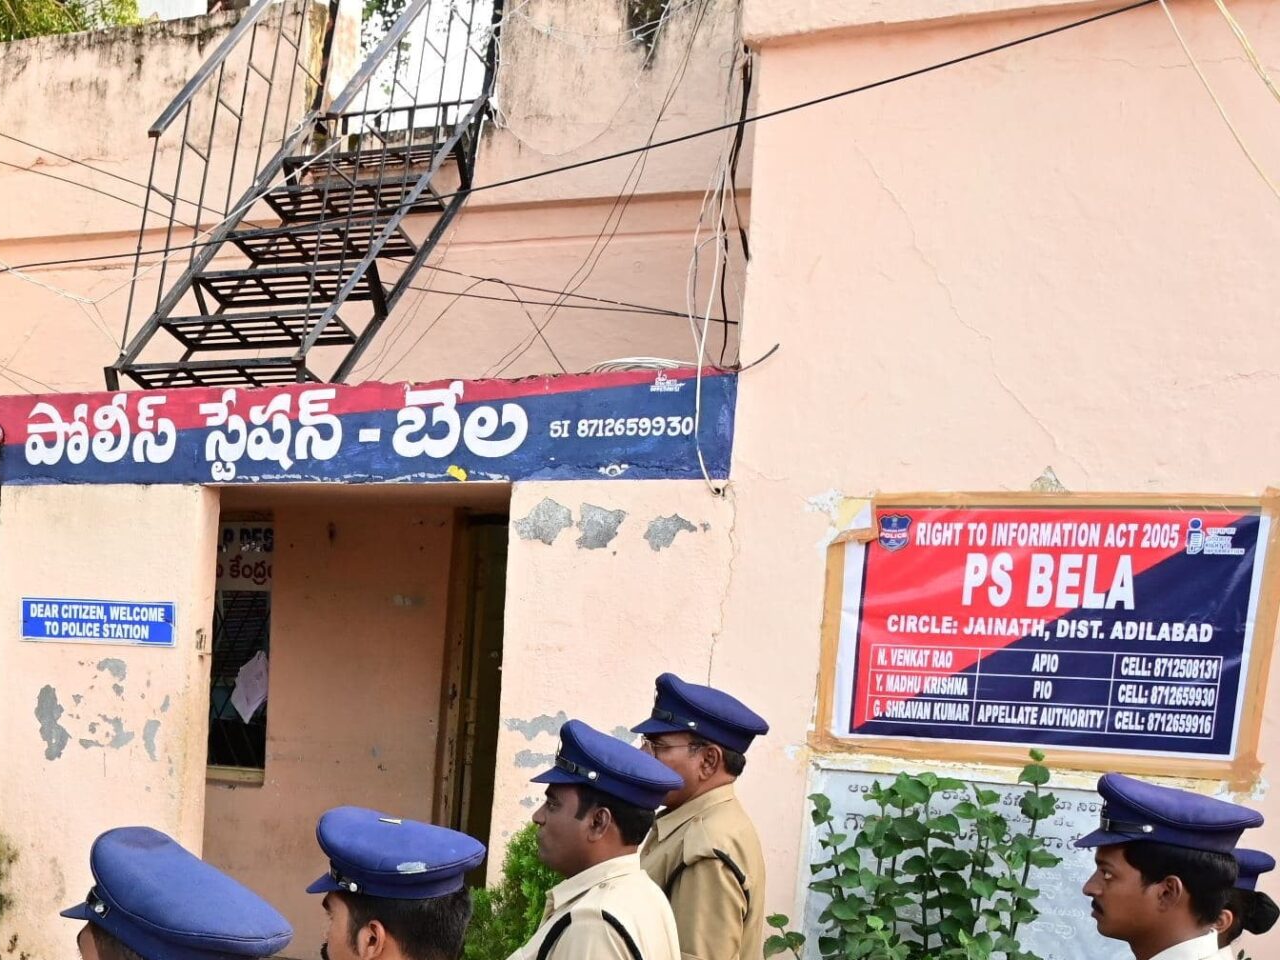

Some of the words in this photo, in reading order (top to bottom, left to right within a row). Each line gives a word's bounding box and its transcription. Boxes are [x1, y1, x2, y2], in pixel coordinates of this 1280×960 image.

[25, 393, 177, 466] పోలీస్
[199, 388, 342, 482] స్టేషన్
[392, 380, 529, 458] బేల
[549, 420, 570, 438] SI
[576, 416, 694, 438] 8712659930
[915, 522, 965, 547] RIGHT
[967, 522, 988, 547] TO
[991, 522, 1102, 548] INFORMATION
[1104, 522, 1140, 549] ACT
[1140, 523, 1181, 549] 2005
[961, 552, 1014, 607] PS
[1026, 553, 1136, 610] BELA
[30, 603, 59, 619] DEAR
[61, 604, 108, 623] CITIZEN,
[109, 606, 166, 623] WELCOME
[44, 621, 59, 636] TO
[61, 621, 100, 637] POLICE
[102, 623, 150, 640] STATION
[887, 614, 959, 634] CIRCLE:
[963, 616, 1051, 642] JAINATH,
[1056, 619, 1105, 640] DIST.
[1109, 621, 1214, 643] ADILABAD
[877, 648, 887, 666] N.
[890, 649, 930, 667] VENKAT
[931, 650, 953, 668] RAO
[1031, 653, 1059, 673] APIO
[1121, 656, 1152, 677] CELL:
[1153, 658, 1219, 680] 8712508131
[875, 674, 883, 692] Y.
[885, 675, 921, 693] MADHU
[923, 677, 969, 696] KRISHNA
[1032, 681, 1053, 700] PIO
[1118, 684, 1149, 704] CELL:
[1150, 685, 1216, 708] 8712659930
[873, 699, 883, 718] G.
[885, 700, 932, 720] SHRAVAN
[933, 702, 970, 722] KUMAR
[977, 704, 1039, 726] APPELLATE
[1039, 707, 1105, 729] AUTHORITY
[1114, 711, 1146, 731] CELL:
[1147, 712, 1212, 735] 8712659916
